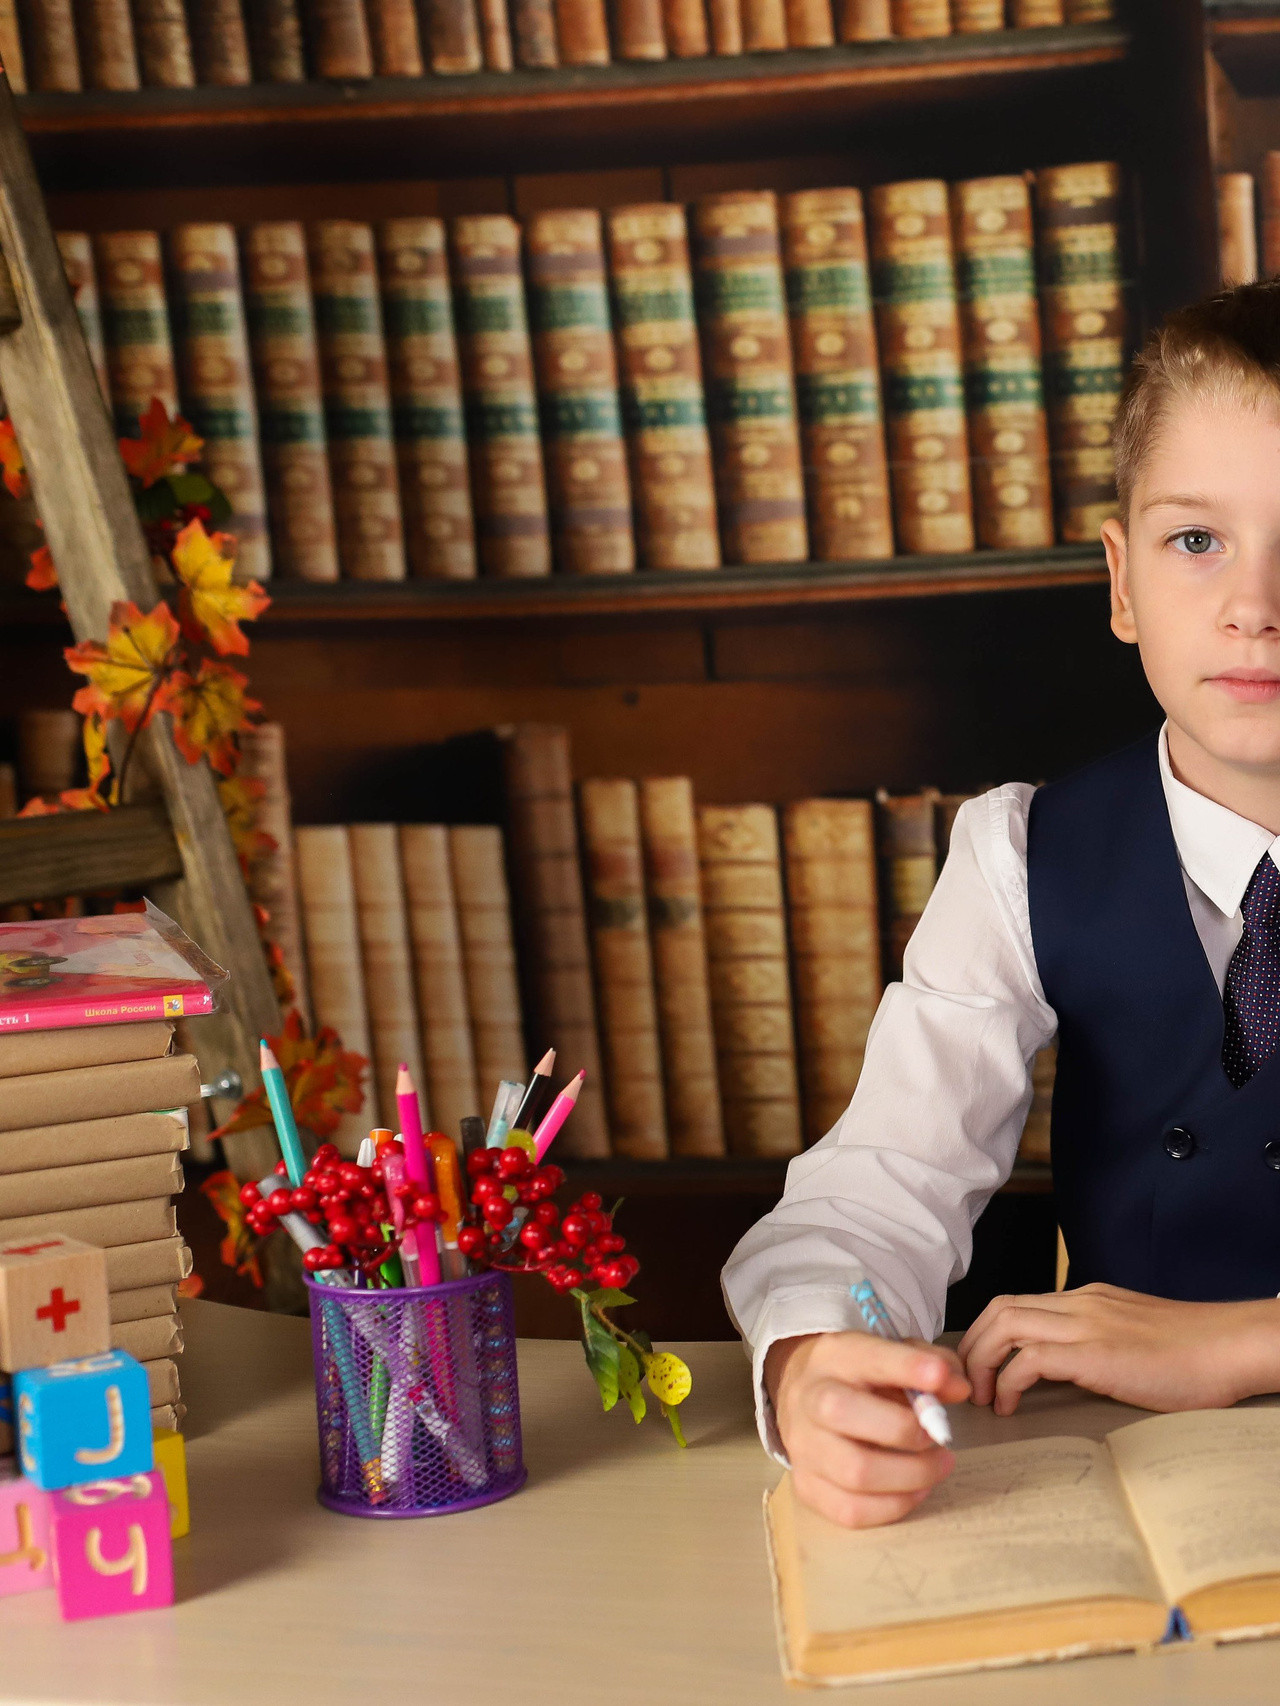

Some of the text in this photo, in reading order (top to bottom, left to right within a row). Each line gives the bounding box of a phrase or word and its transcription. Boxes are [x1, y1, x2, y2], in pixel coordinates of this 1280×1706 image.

[85, 1004, 156, 1018] Школа России
[24, 1012, 30, 1024] 1
